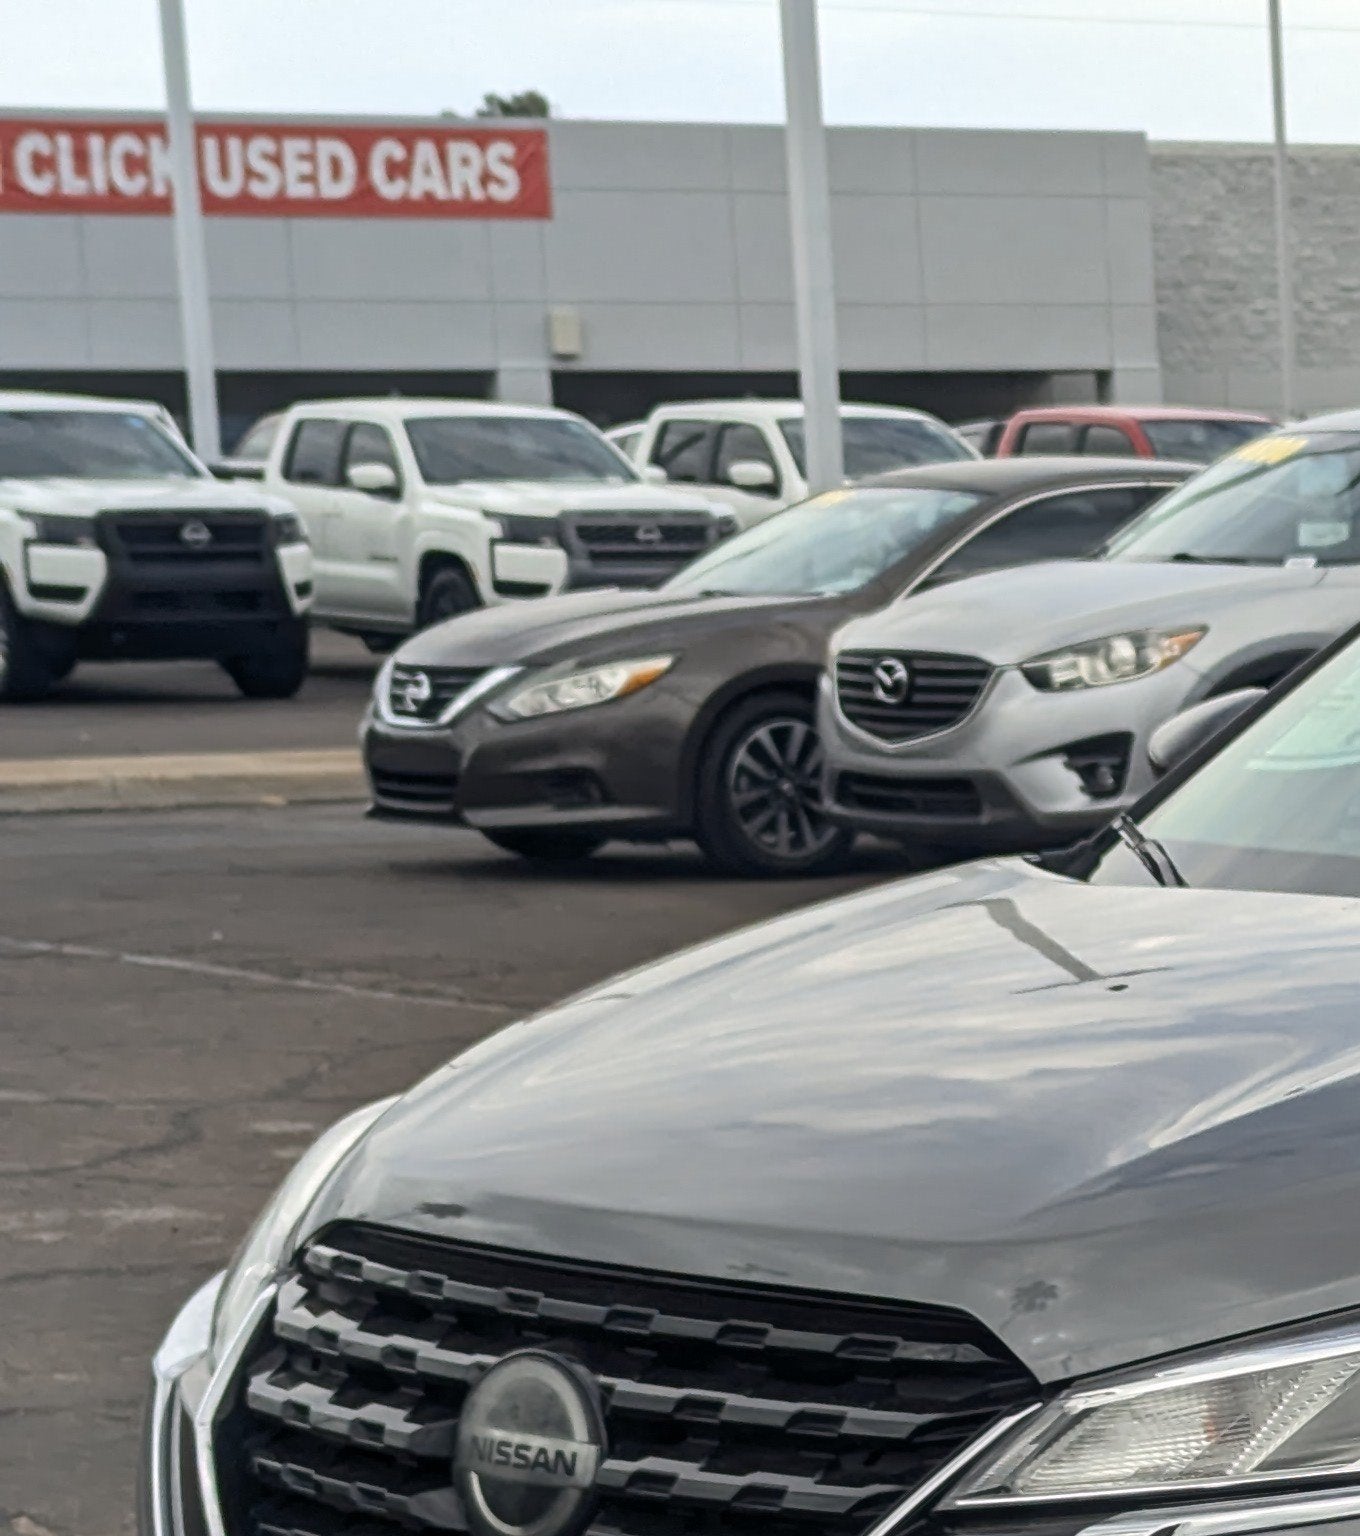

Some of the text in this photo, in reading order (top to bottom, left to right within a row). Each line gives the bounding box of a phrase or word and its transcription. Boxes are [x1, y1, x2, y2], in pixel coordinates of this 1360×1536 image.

[202, 135, 358, 200] USED
[368, 138, 522, 202] CARS
[471, 1435, 578, 1477] NISSAN
